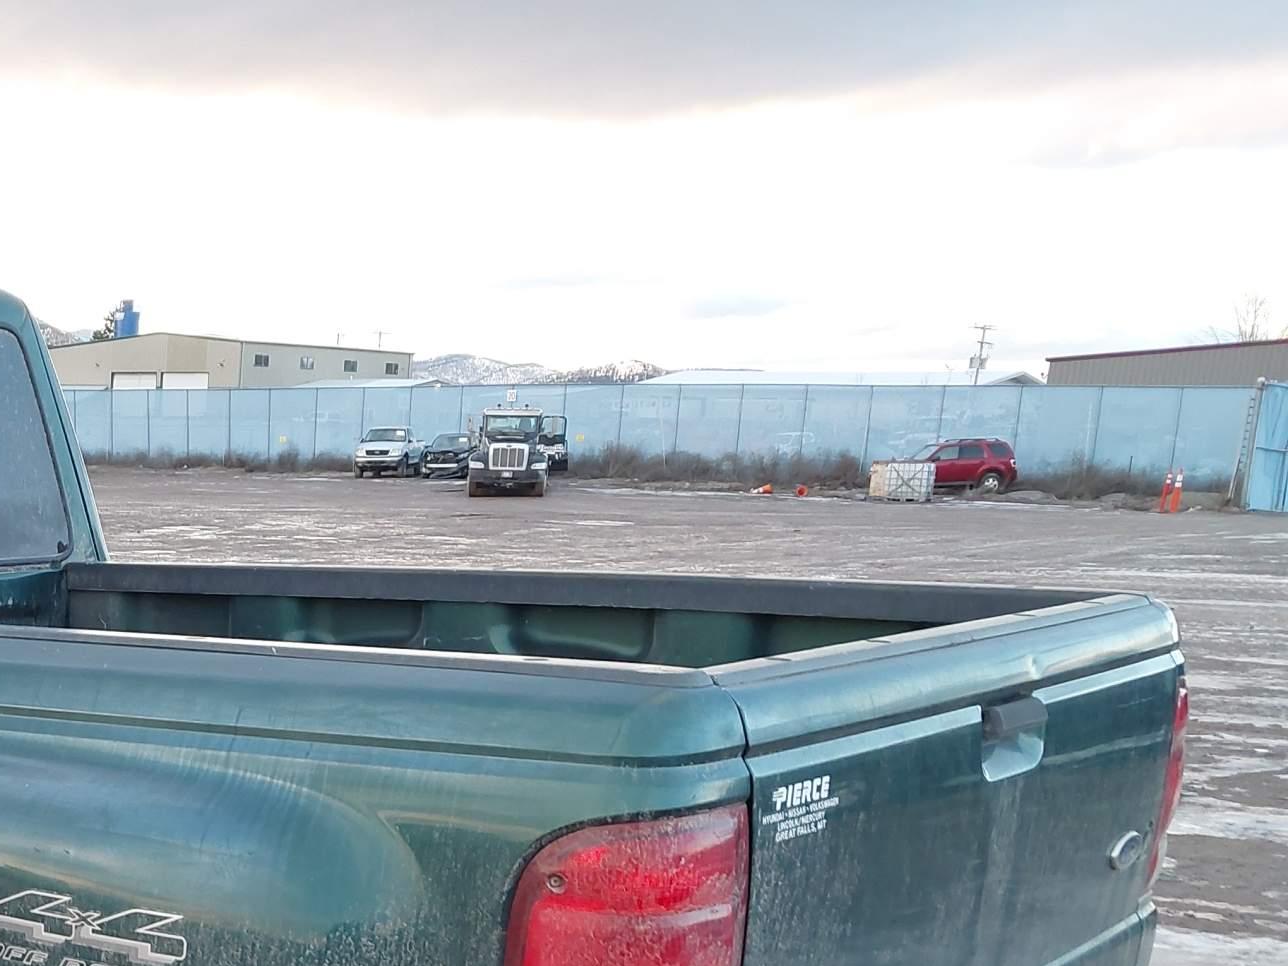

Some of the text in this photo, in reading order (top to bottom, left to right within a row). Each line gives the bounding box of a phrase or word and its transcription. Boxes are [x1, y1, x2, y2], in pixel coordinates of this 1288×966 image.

[772, 775, 830, 811] PIERCE
[762, 811, 785, 825] HYUNDAI
[788, 805, 807, 818] NISSAN
[775, 827, 796, 842] GREAT
[817, 819, 827, 830] MT
